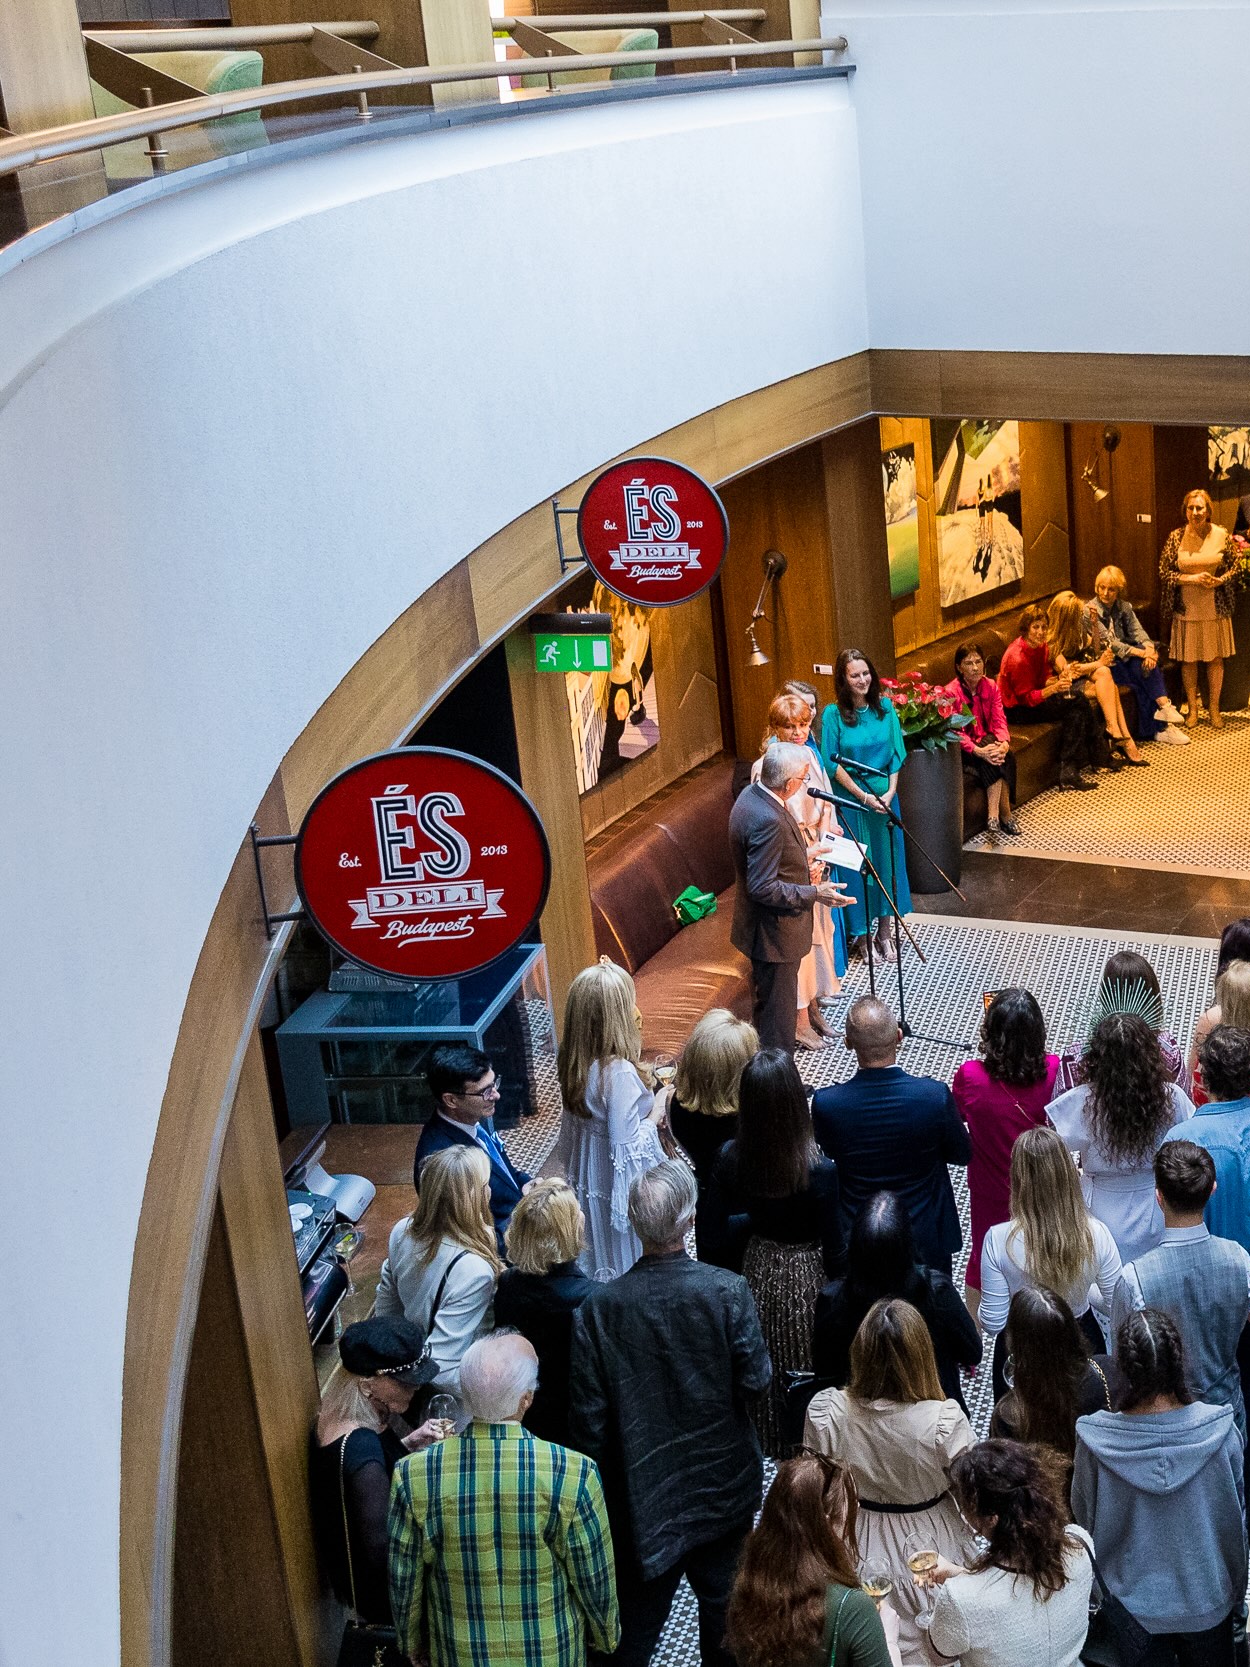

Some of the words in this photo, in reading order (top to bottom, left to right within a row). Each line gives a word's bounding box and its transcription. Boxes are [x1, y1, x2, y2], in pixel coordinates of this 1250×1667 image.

[623, 478, 682, 542] ÉS
[603, 519, 618, 531] Est.
[686, 520, 703, 529] 2013
[624, 546, 686, 558] DELI
[626, 564, 683, 584] Budapest
[370, 784, 471, 884] ÉS
[338, 852, 362, 868] Est.
[480, 844, 508, 857] 2013
[376, 886, 480, 910] DELI
[380, 914, 475, 949] Budapest
